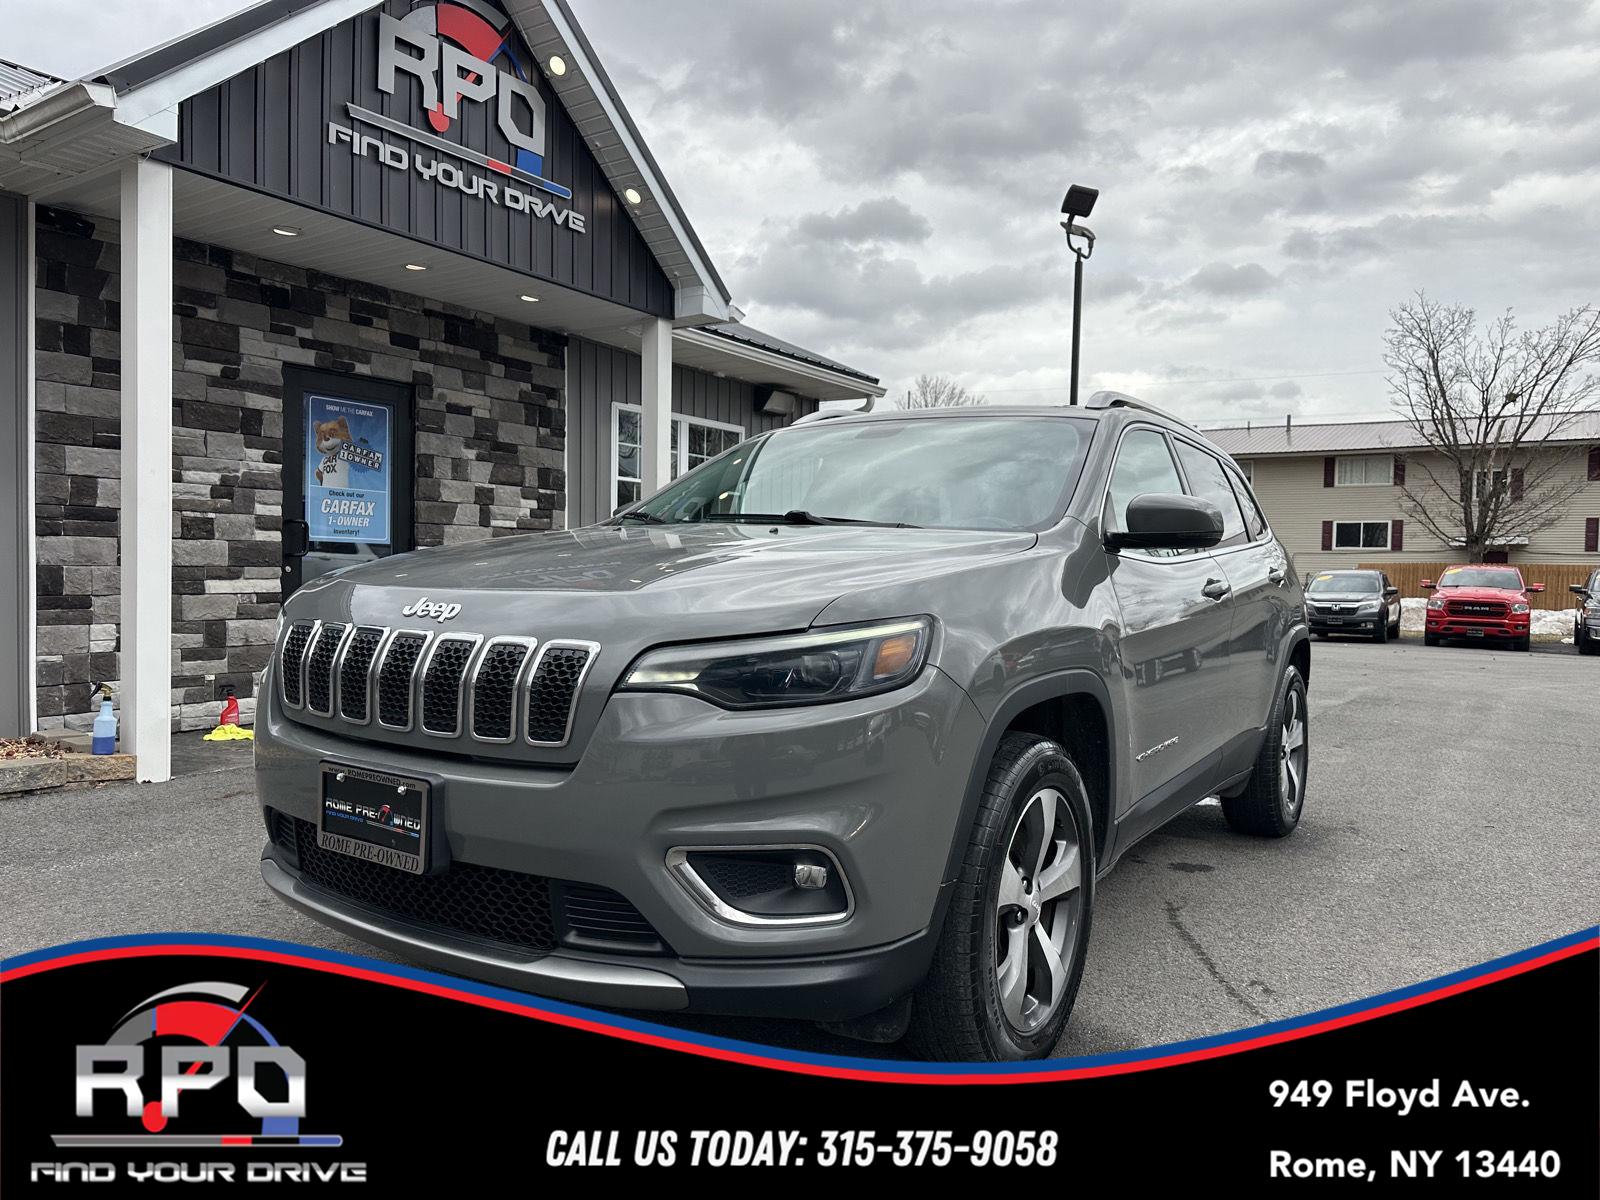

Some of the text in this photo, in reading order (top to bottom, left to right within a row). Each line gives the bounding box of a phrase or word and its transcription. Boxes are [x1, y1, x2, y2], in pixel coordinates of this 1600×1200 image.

[328, 121, 586, 234] FIND YOUR DRIVE
[342, 443, 382, 461] CARFAX
[323, 463, 337, 474] FOX
[348, 454, 380, 469] OWNER
[329, 490, 344, 498] Check
[321, 499, 375, 516] CARFAX
[328, 516, 370, 527] 1-OWNER
[402, 597, 462, 623] Jeep
[326, 798, 352, 812] ROME
[322, 833, 419, 872] ROME PRE-OWNED
